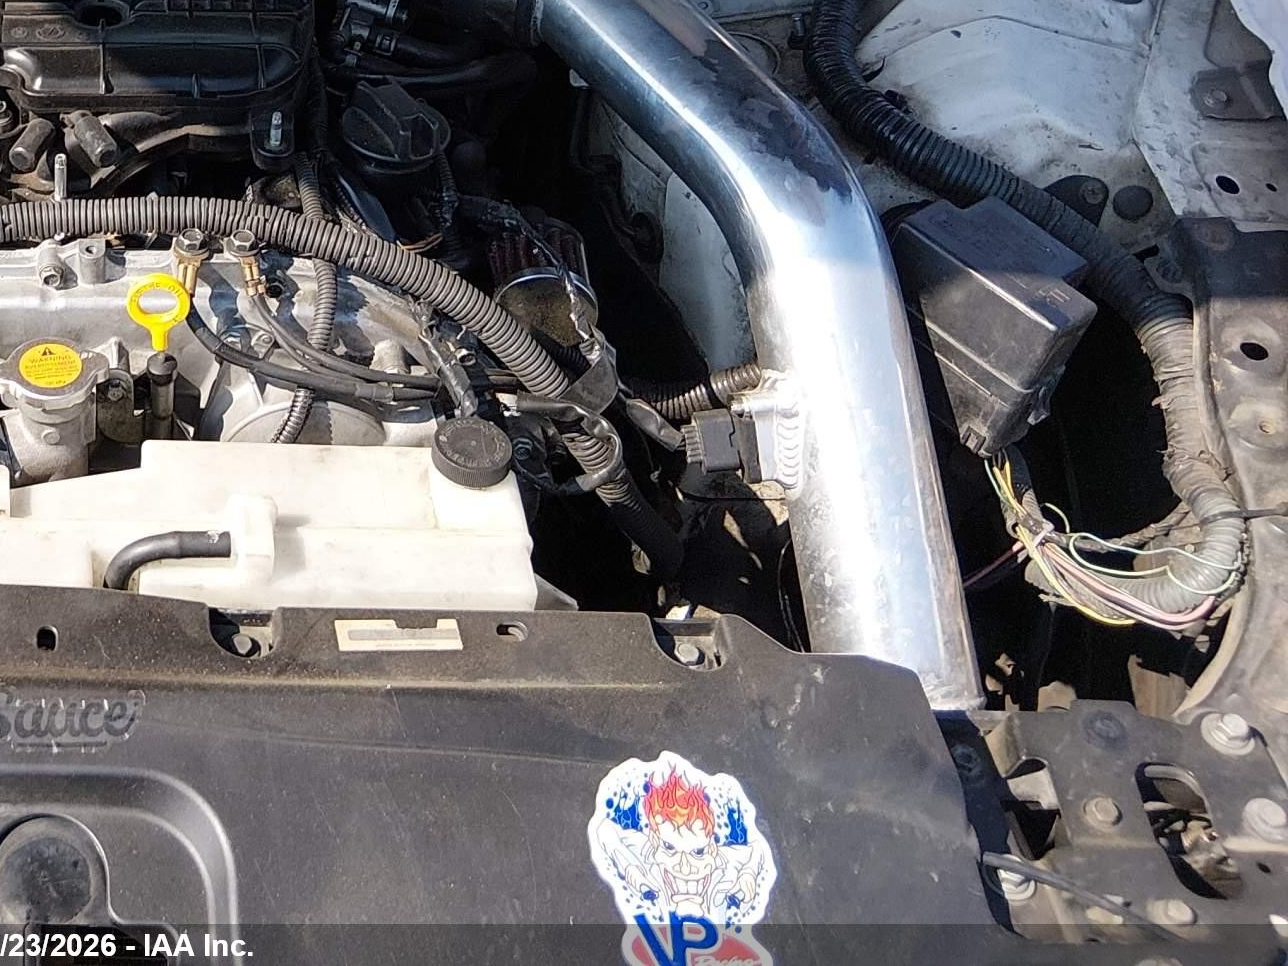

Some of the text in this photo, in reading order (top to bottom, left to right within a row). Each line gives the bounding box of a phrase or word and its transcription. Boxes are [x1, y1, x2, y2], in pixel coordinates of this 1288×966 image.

[167, 284, 183, 298] OIL
[29, 354, 72, 364] WARNING
[633, 910, 719, 966] VP
